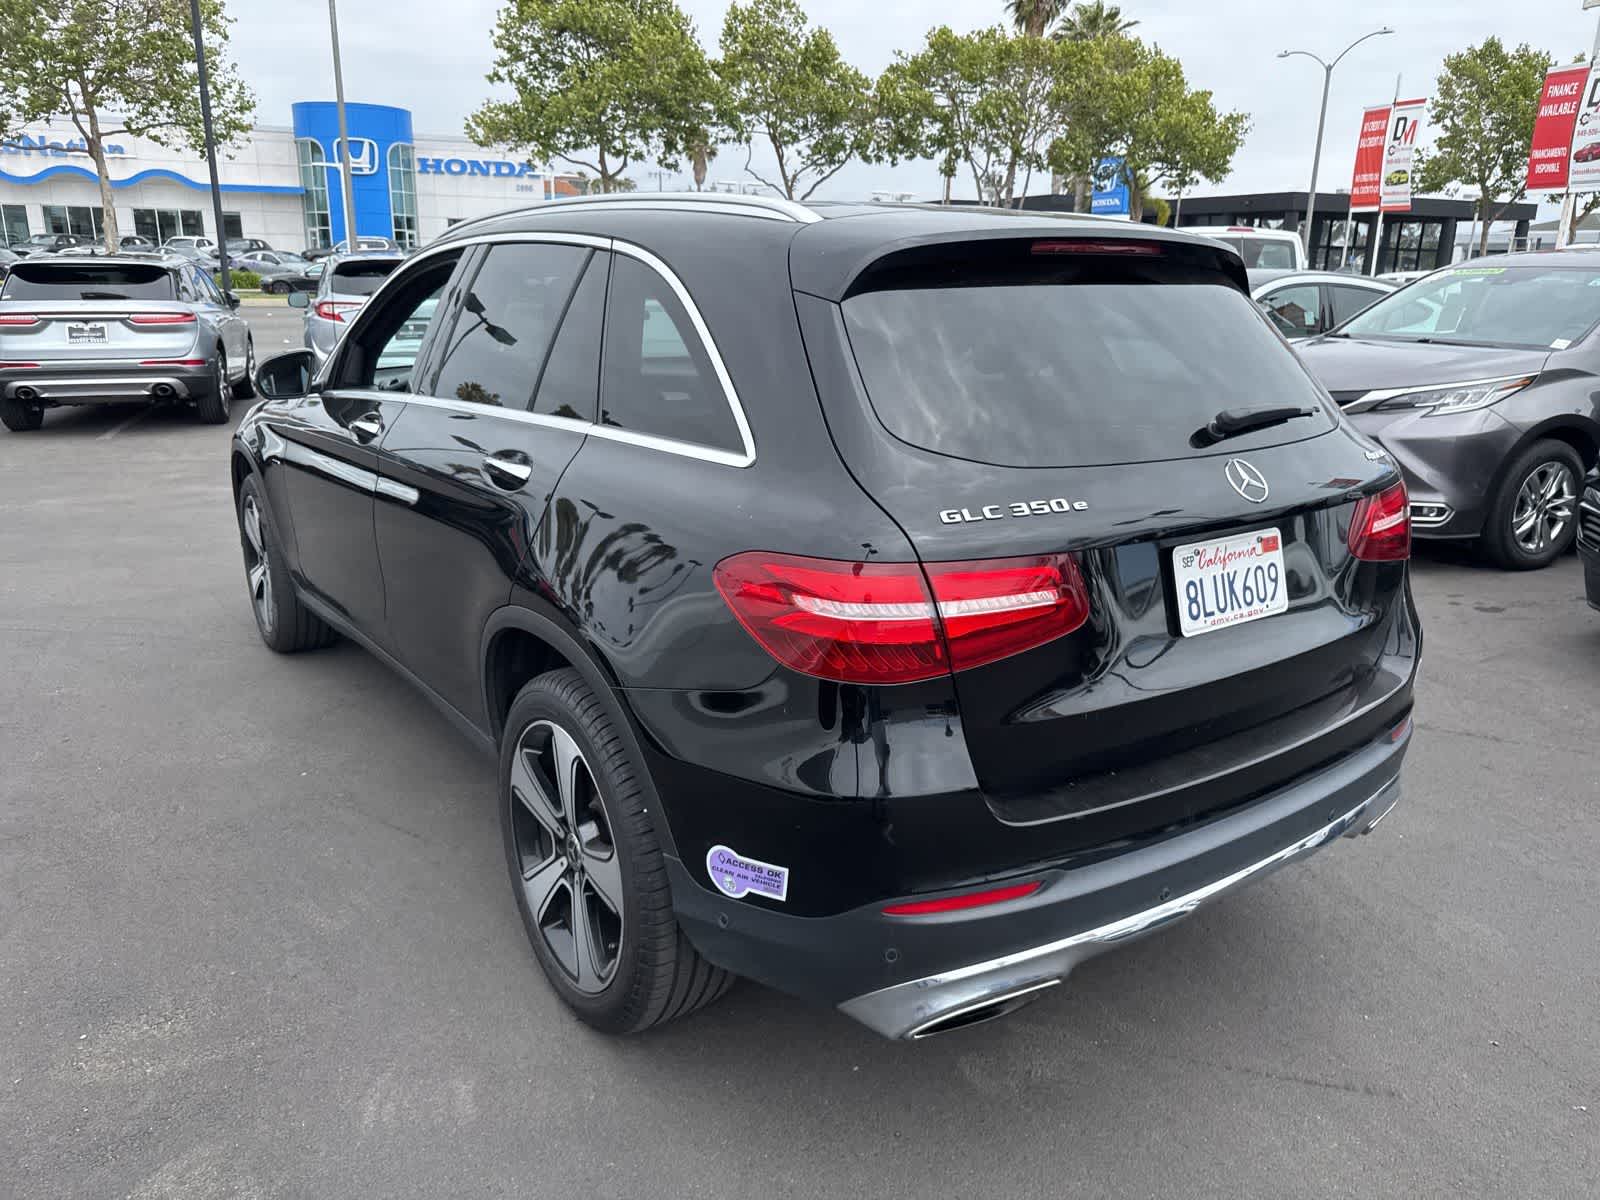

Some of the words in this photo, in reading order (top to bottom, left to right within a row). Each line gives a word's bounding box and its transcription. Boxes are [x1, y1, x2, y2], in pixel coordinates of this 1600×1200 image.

[1547, 82, 1579, 98] FINANCE
[1540, 101, 1577, 117] AVAILABLE
[1393, 116, 1418, 145] DM
[417, 157, 541, 178] HONDA
[939, 504, 1004, 524] GLC
[1182, 555, 1195, 568] SEP
[1198, 544, 1264, 571] California
[1185, 562, 1279, 621] 8LUK609
[1210, 607, 1264, 626] dmv.ca.gov
[712, 865, 735, 876] CLEAN
[737, 873, 749, 881] AIR
[751, 877, 781, 889] VEHICLE
[726, 858, 763, 874] ACCESS
[768, 870, 782, 879] OK
